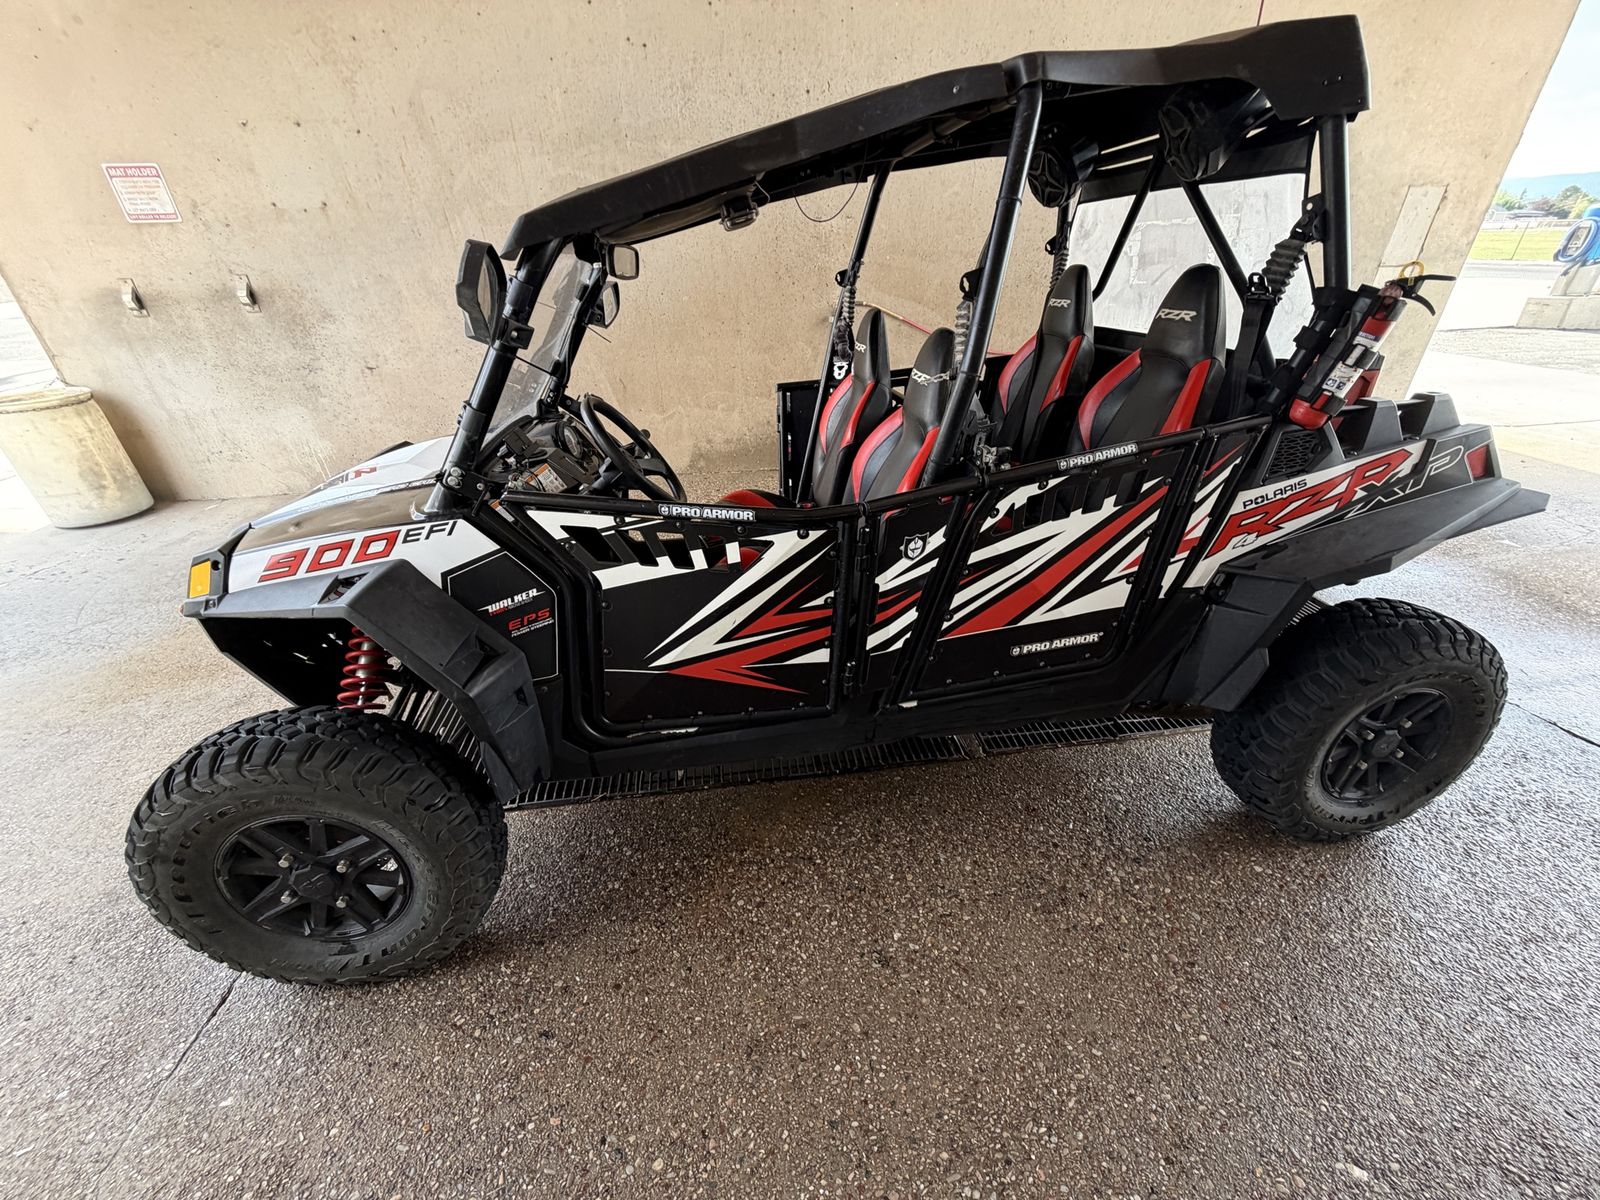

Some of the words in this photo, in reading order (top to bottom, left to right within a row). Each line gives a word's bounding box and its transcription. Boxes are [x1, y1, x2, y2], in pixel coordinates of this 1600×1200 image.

[107, 167, 126, 177] MAT
[125, 167, 159, 177] HOLDER
[1048, 298, 1071, 308] RZR
[1155, 308, 1197, 322] RZR
[1069, 455, 1094, 468] PRO
[1094, 443, 1137, 462] ARMOR
[1202, 448, 1413, 560] RZR
[1242, 479, 1308, 510] POLARIS
[672, 506, 701, 518] PRO
[702, 509, 754, 521] ARMOR
[257, 529, 402, 583] 900
[402, 520, 458, 544] EFI
[1232, 532, 1259, 549] 4
[477, 588, 545, 613] WALKER
[508, 607, 550, 631] EPS
[1023, 642, 1050, 654] PRO
[1051, 633, 1099, 649] ARMOR
